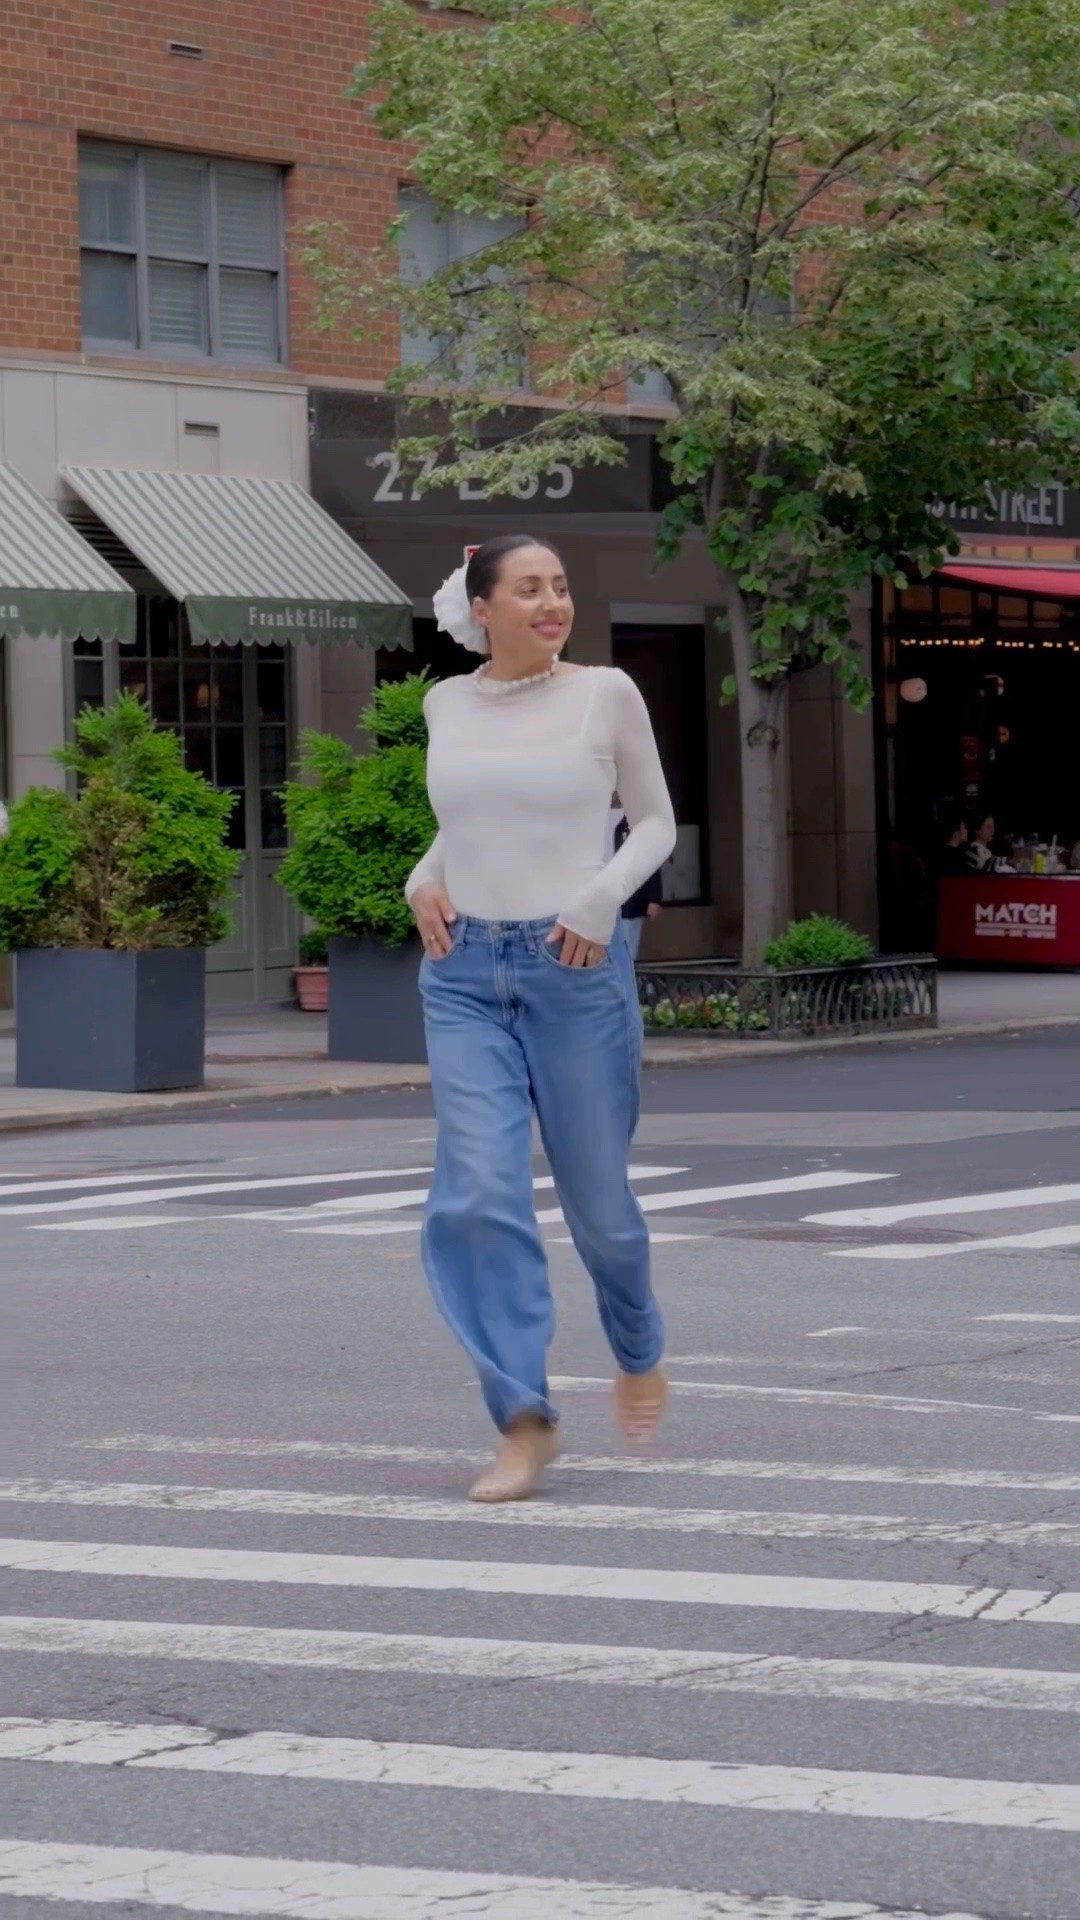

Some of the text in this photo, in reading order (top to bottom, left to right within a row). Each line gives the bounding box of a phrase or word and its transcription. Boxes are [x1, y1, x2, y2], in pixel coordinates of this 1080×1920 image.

[372, 451, 438, 502] 27
[248, 605, 357, 629] Frank&Eileen
[975, 902, 1058, 924] MATCH
